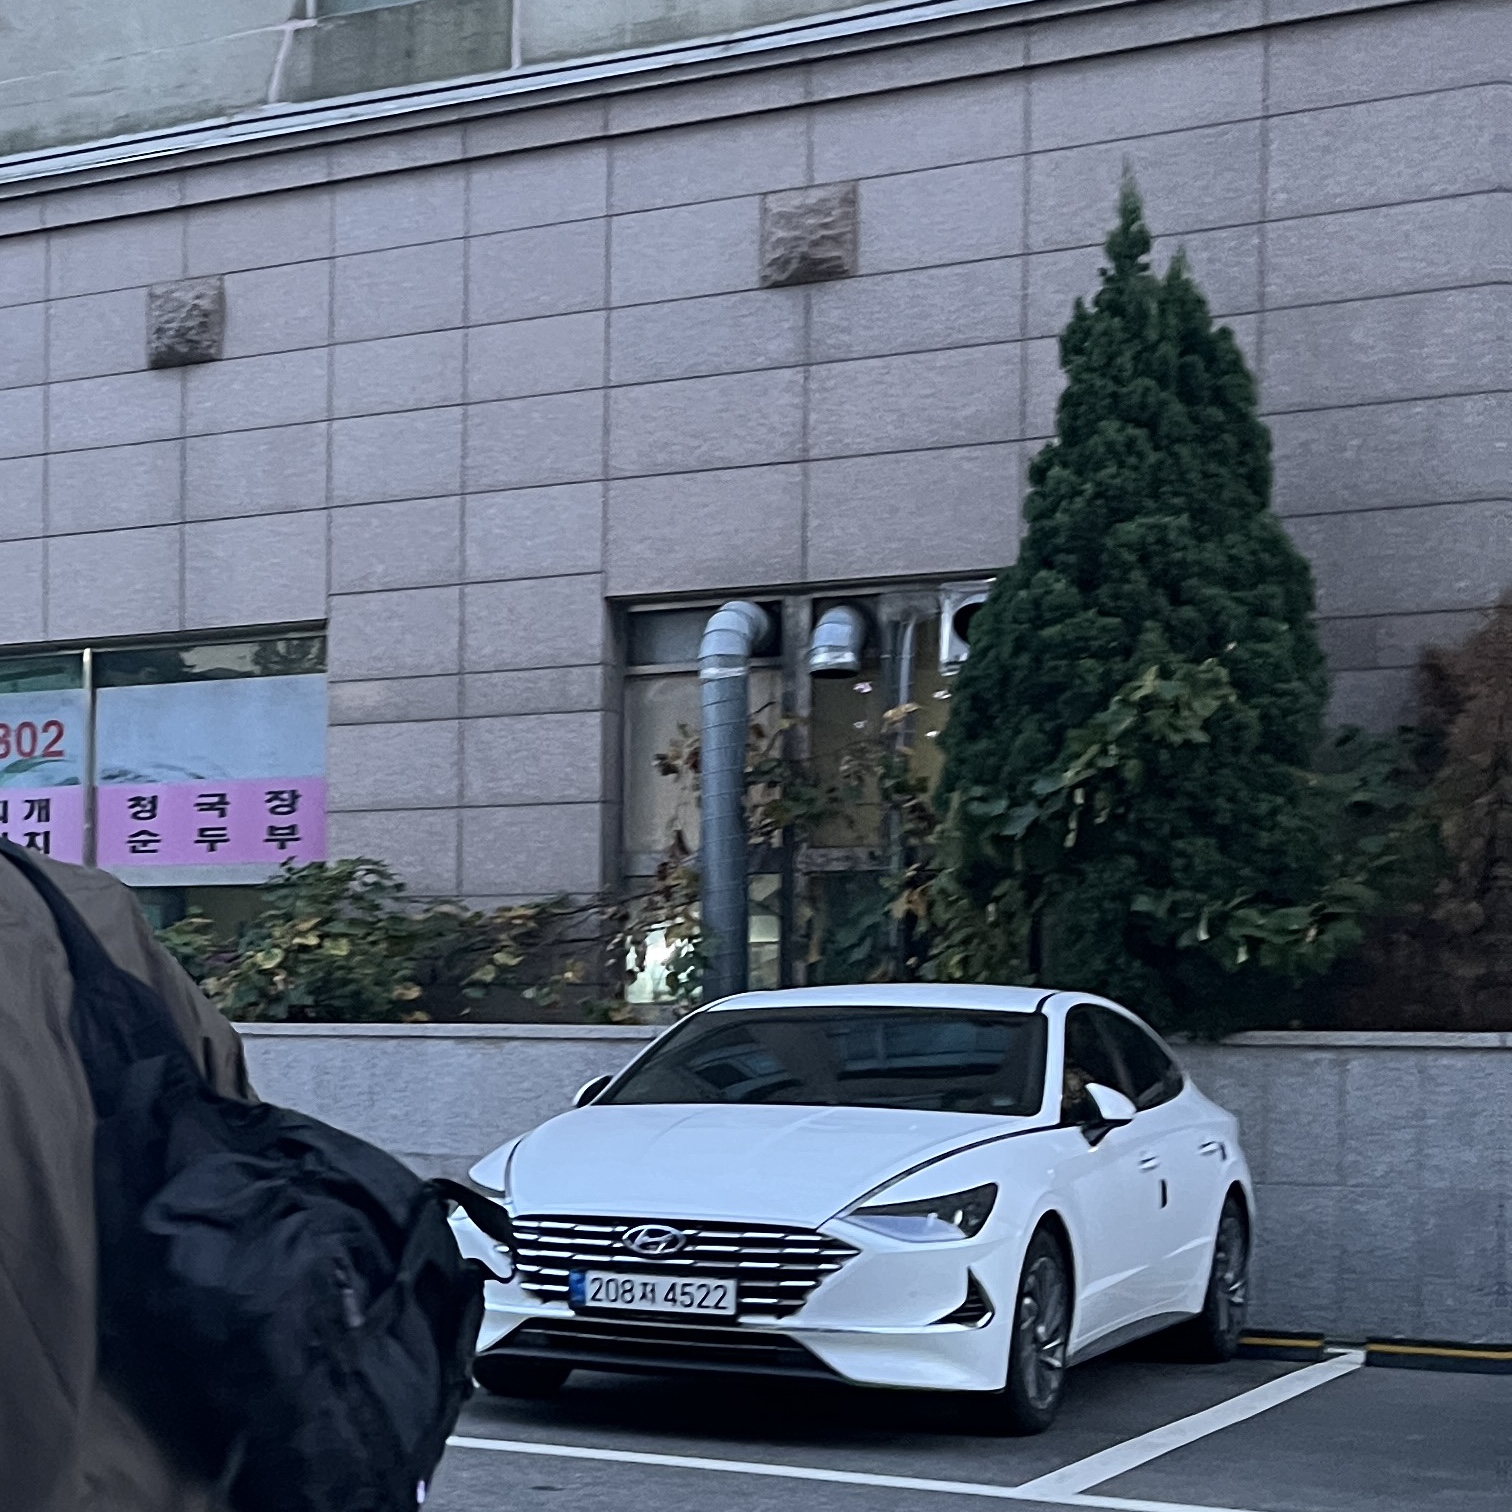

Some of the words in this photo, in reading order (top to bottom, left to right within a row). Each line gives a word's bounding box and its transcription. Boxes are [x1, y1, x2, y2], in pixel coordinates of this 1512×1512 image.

[126, 789, 302, 821] 청국장
[125, 823, 303, 854] 순두부
[662, 1281, 729, 1310] 4522
